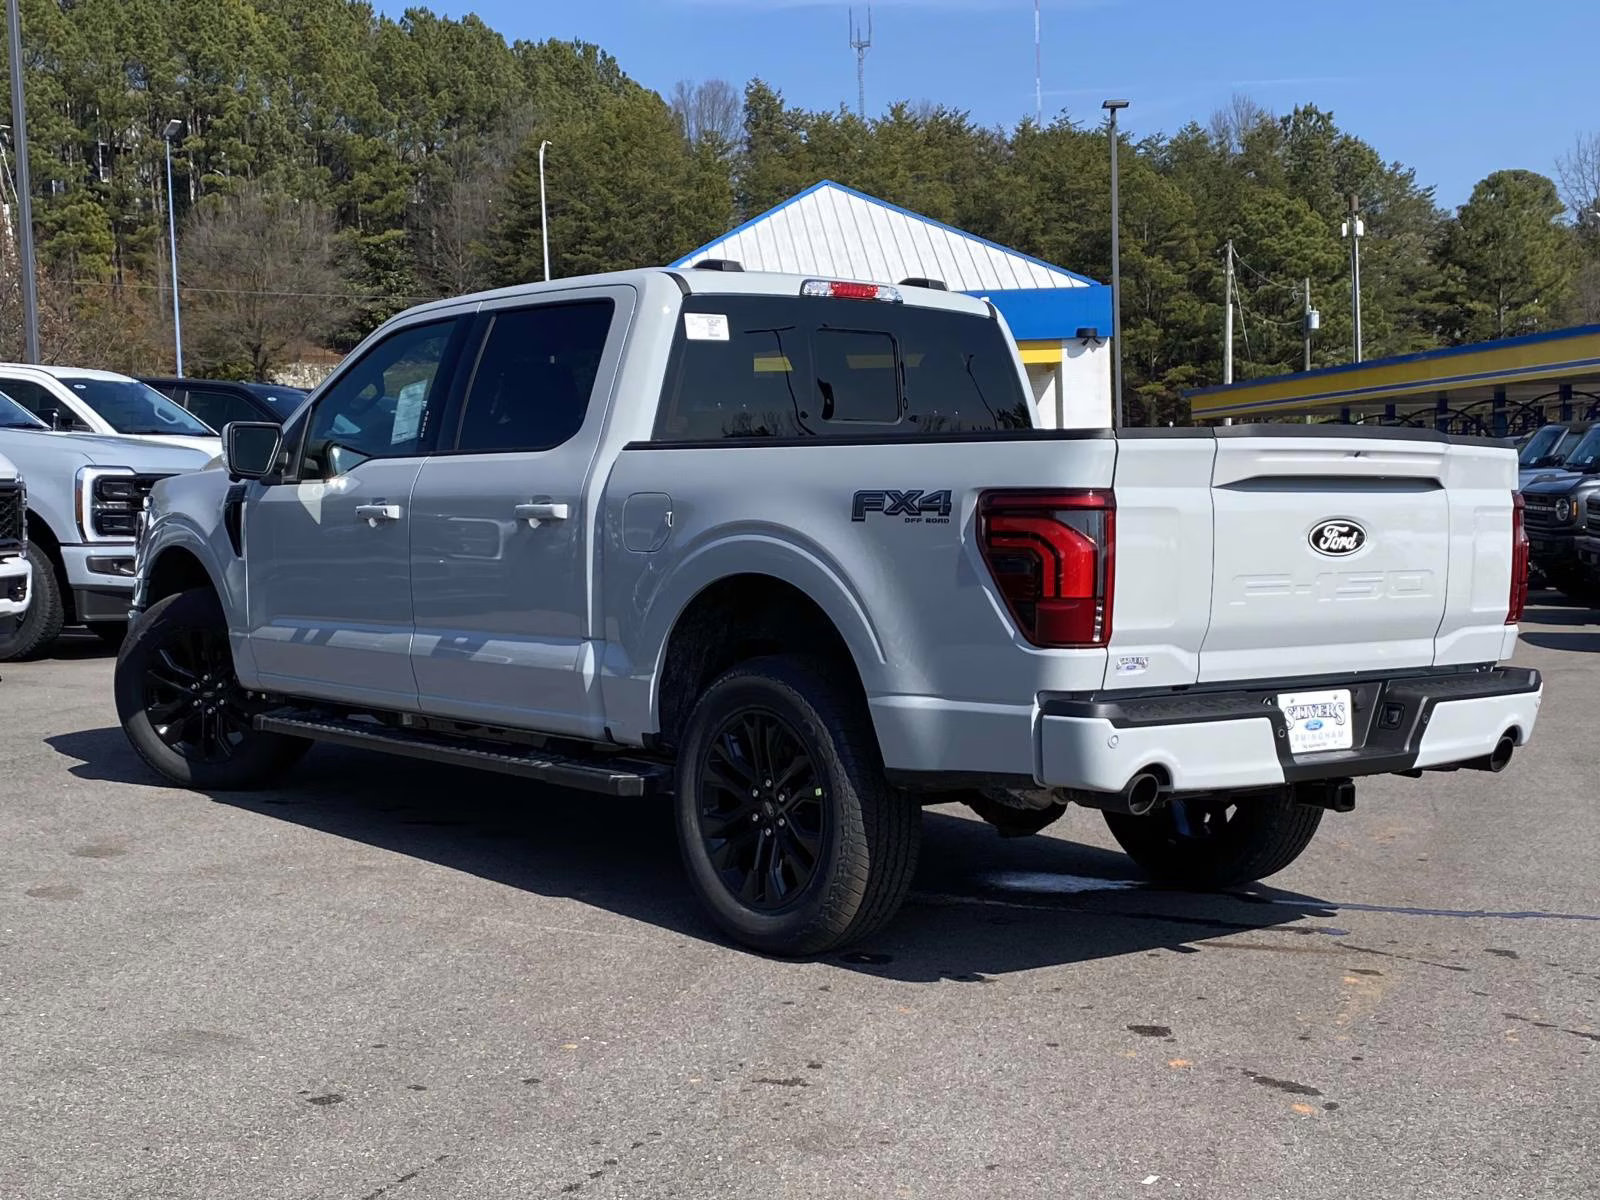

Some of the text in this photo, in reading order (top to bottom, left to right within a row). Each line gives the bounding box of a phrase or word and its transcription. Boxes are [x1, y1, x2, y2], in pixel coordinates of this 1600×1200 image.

[851, 489, 953, 522] FX4
[1319, 525, 1358, 550] Ford
[1284, 702, 1346, 731] STIVERS
